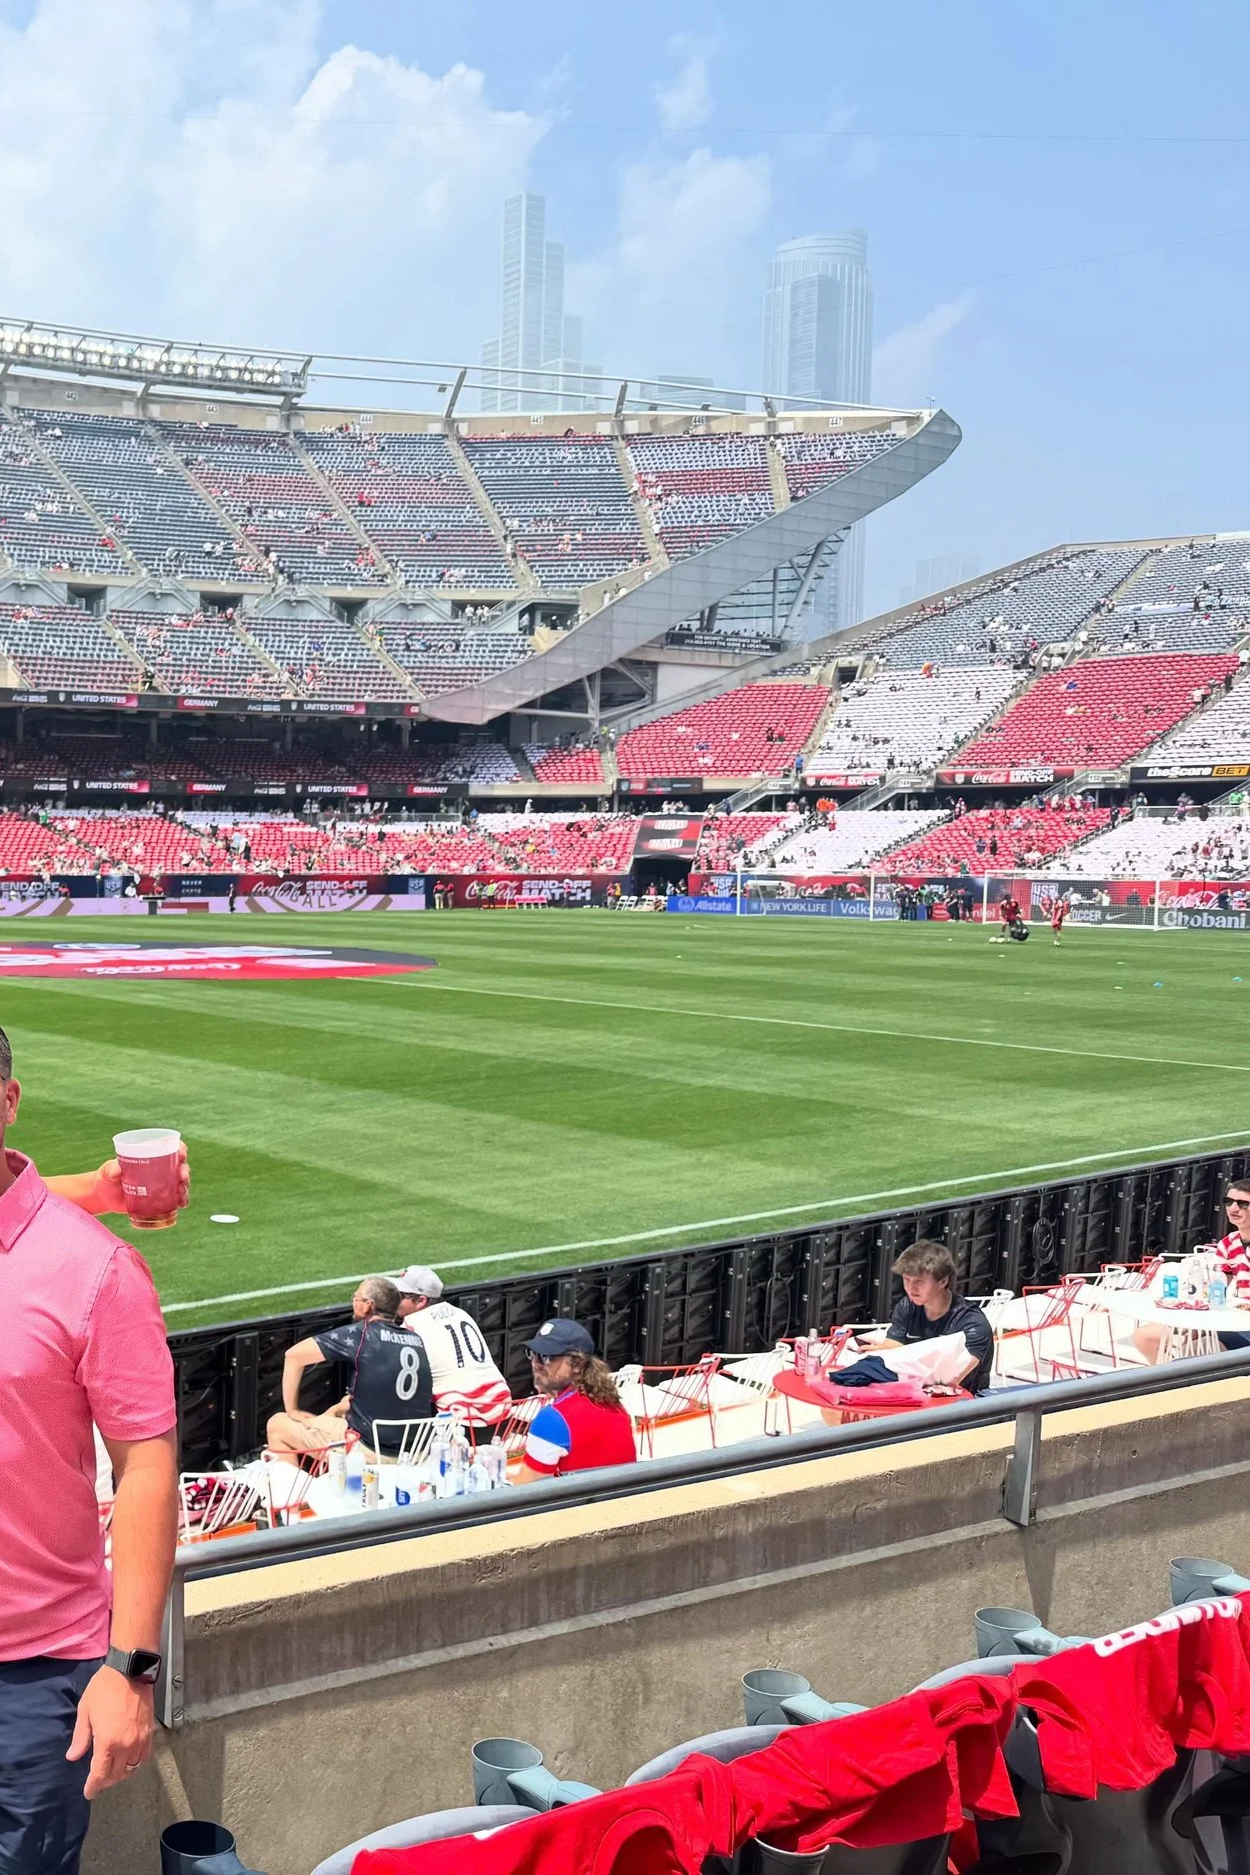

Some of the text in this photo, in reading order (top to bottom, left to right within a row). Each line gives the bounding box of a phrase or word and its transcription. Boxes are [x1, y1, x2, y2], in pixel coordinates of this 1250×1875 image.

[361, 414, 373, 424] 444
[72, 694, 127, 704] UNITED STATES
[183, 699, 219, 708] GERMANY
[304, 703, 355, 712] UNITED STATES
[1147, 765, 1244, 778] theScore BET
[971, 770, 1009, 784] Coca-Cola
[1010, 774, 1054, 783] MATCH
[85, 781, 138, 790] UNITED STATES
[192, 783, 226, 792] GERMANY
[308, 785, 357, 793] UNITED STATES
[413, 786, 448, 794] GERMANY
[252, 881, 304, 899] Coca-Cola
[695, 900, 732, 912] Allstate
[760, 902, 827, 913] NEW YORK LIFE
[444, 1320, 486, 1368] 10
[395, 1346, 420, 1401] 8
